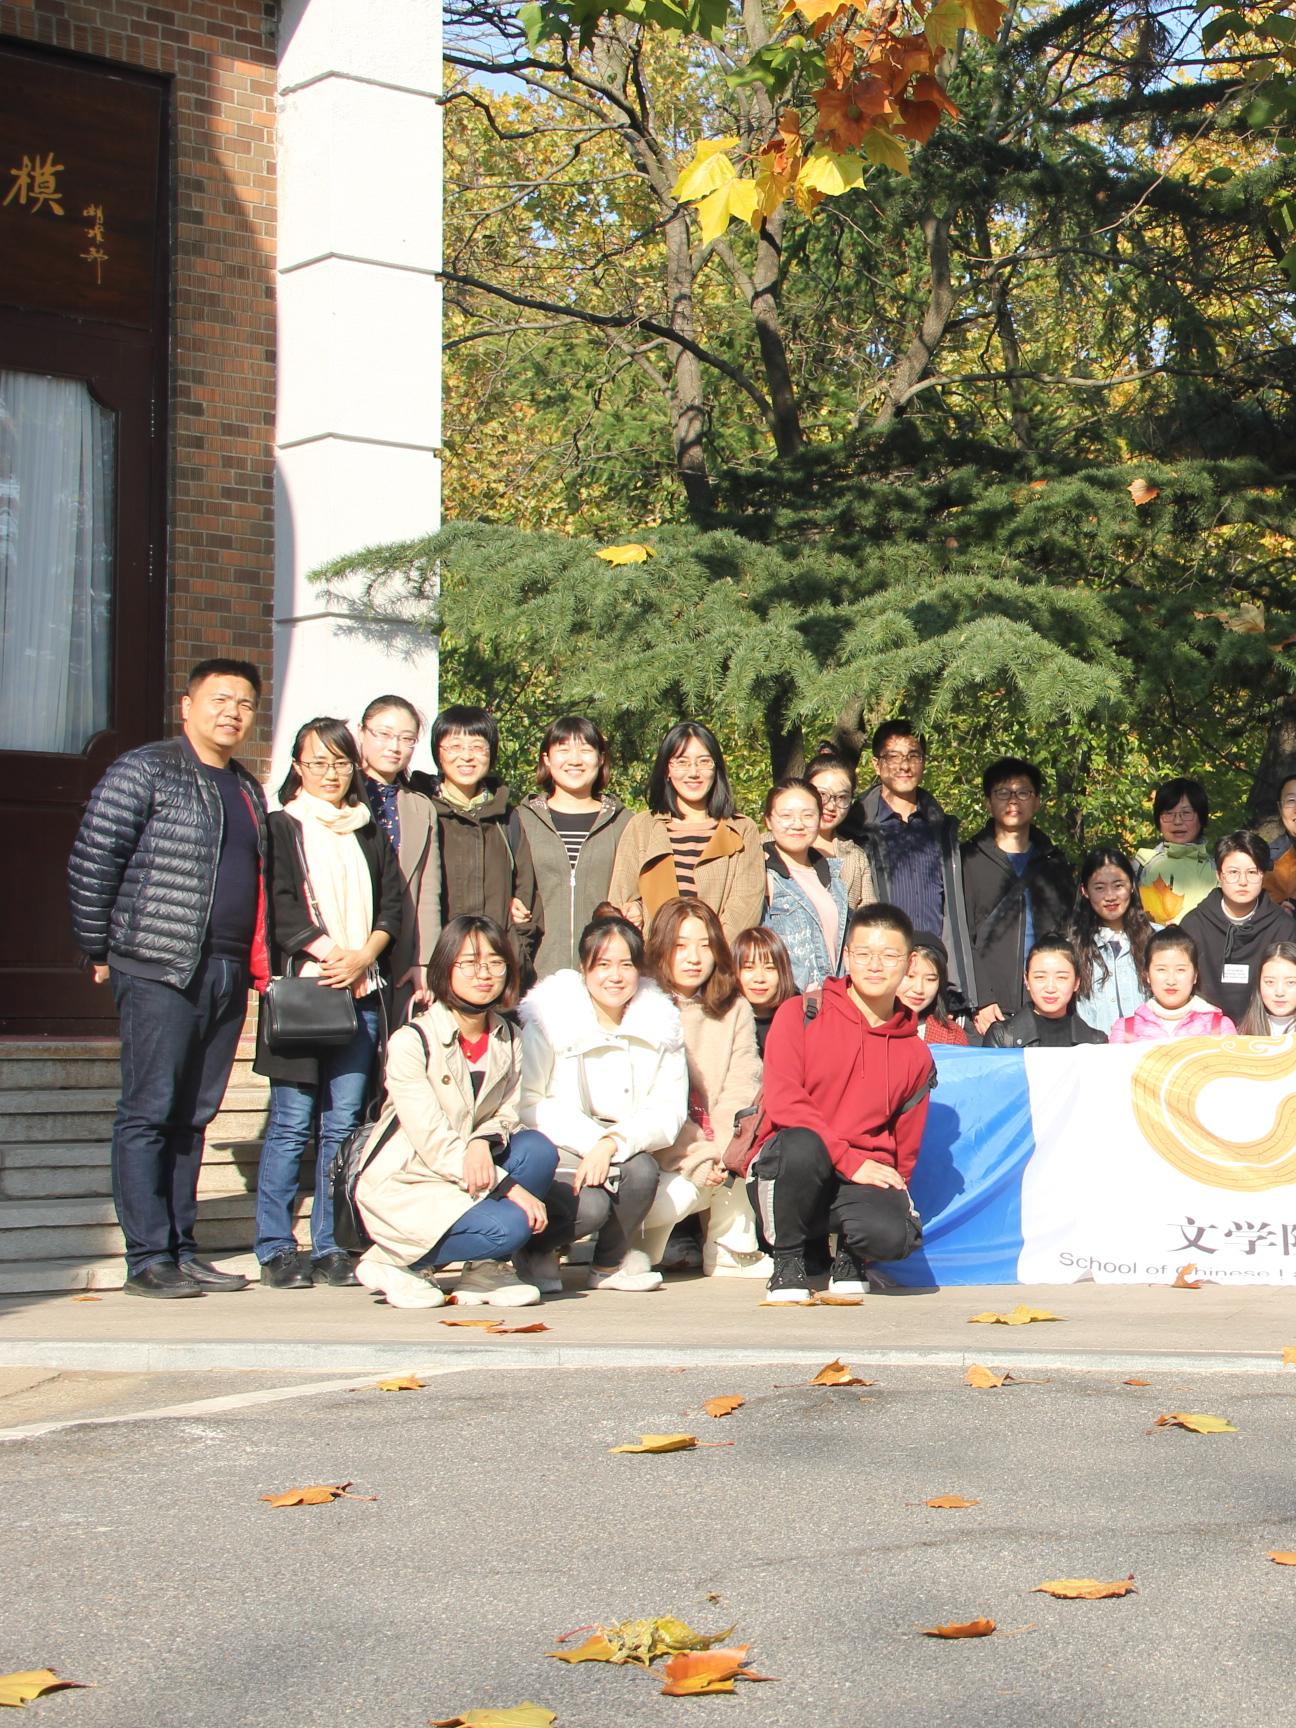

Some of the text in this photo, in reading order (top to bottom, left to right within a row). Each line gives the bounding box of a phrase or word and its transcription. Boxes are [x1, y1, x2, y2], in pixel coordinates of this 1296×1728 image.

[3, 152, 65, 216] 模
[1058, 1252, 1137, 1275] School
[1145, 1264, 1169, 1275] of
